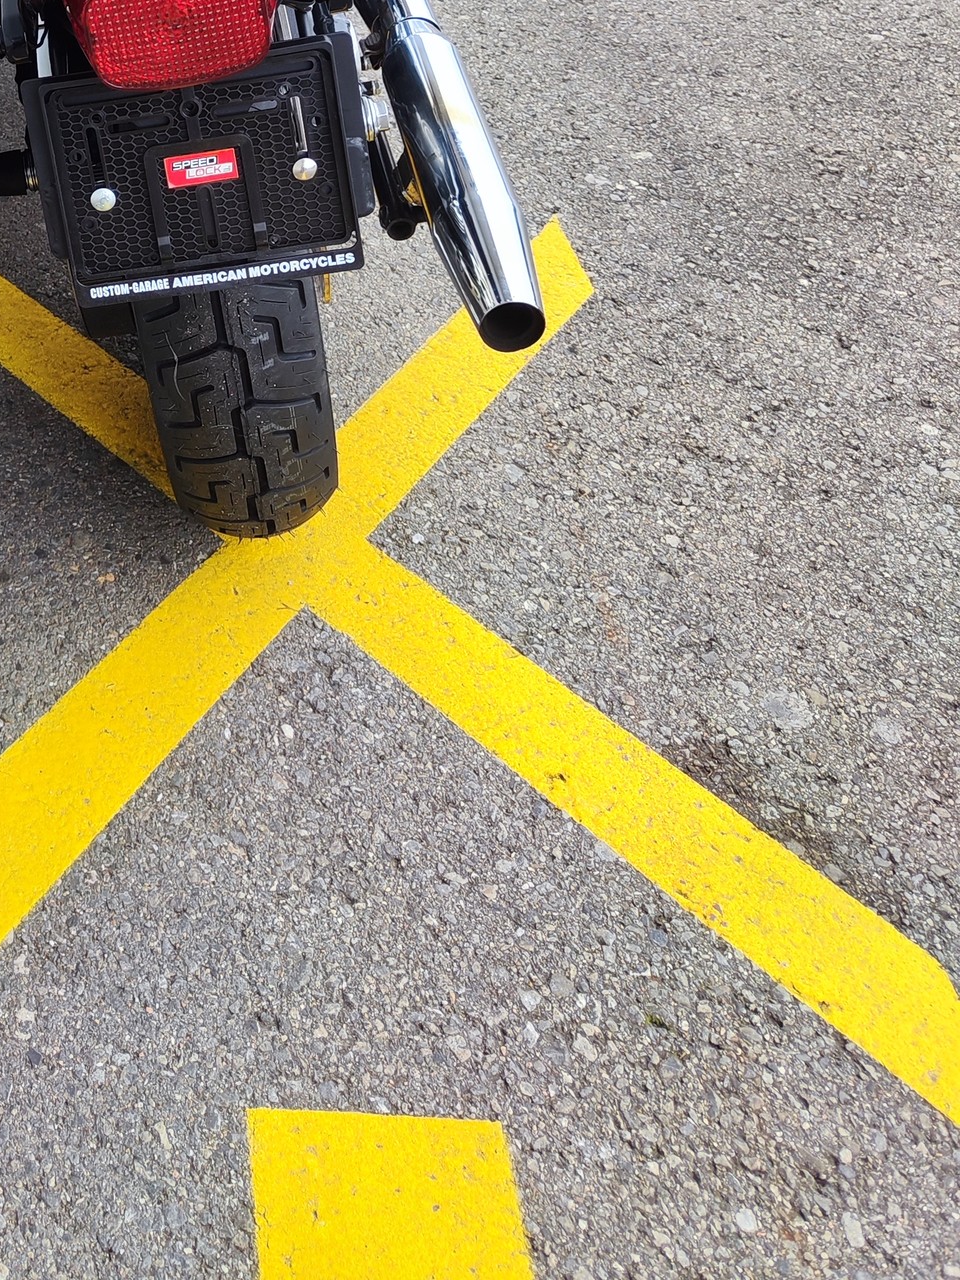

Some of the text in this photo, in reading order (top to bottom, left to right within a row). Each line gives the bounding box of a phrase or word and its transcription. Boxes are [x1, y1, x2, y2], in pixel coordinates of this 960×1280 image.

[172, 156, 218, 171] SPEED
[90, 251, 356, 299] CUSTOM-GARAGE AMERICAN MOTORCYCLES
